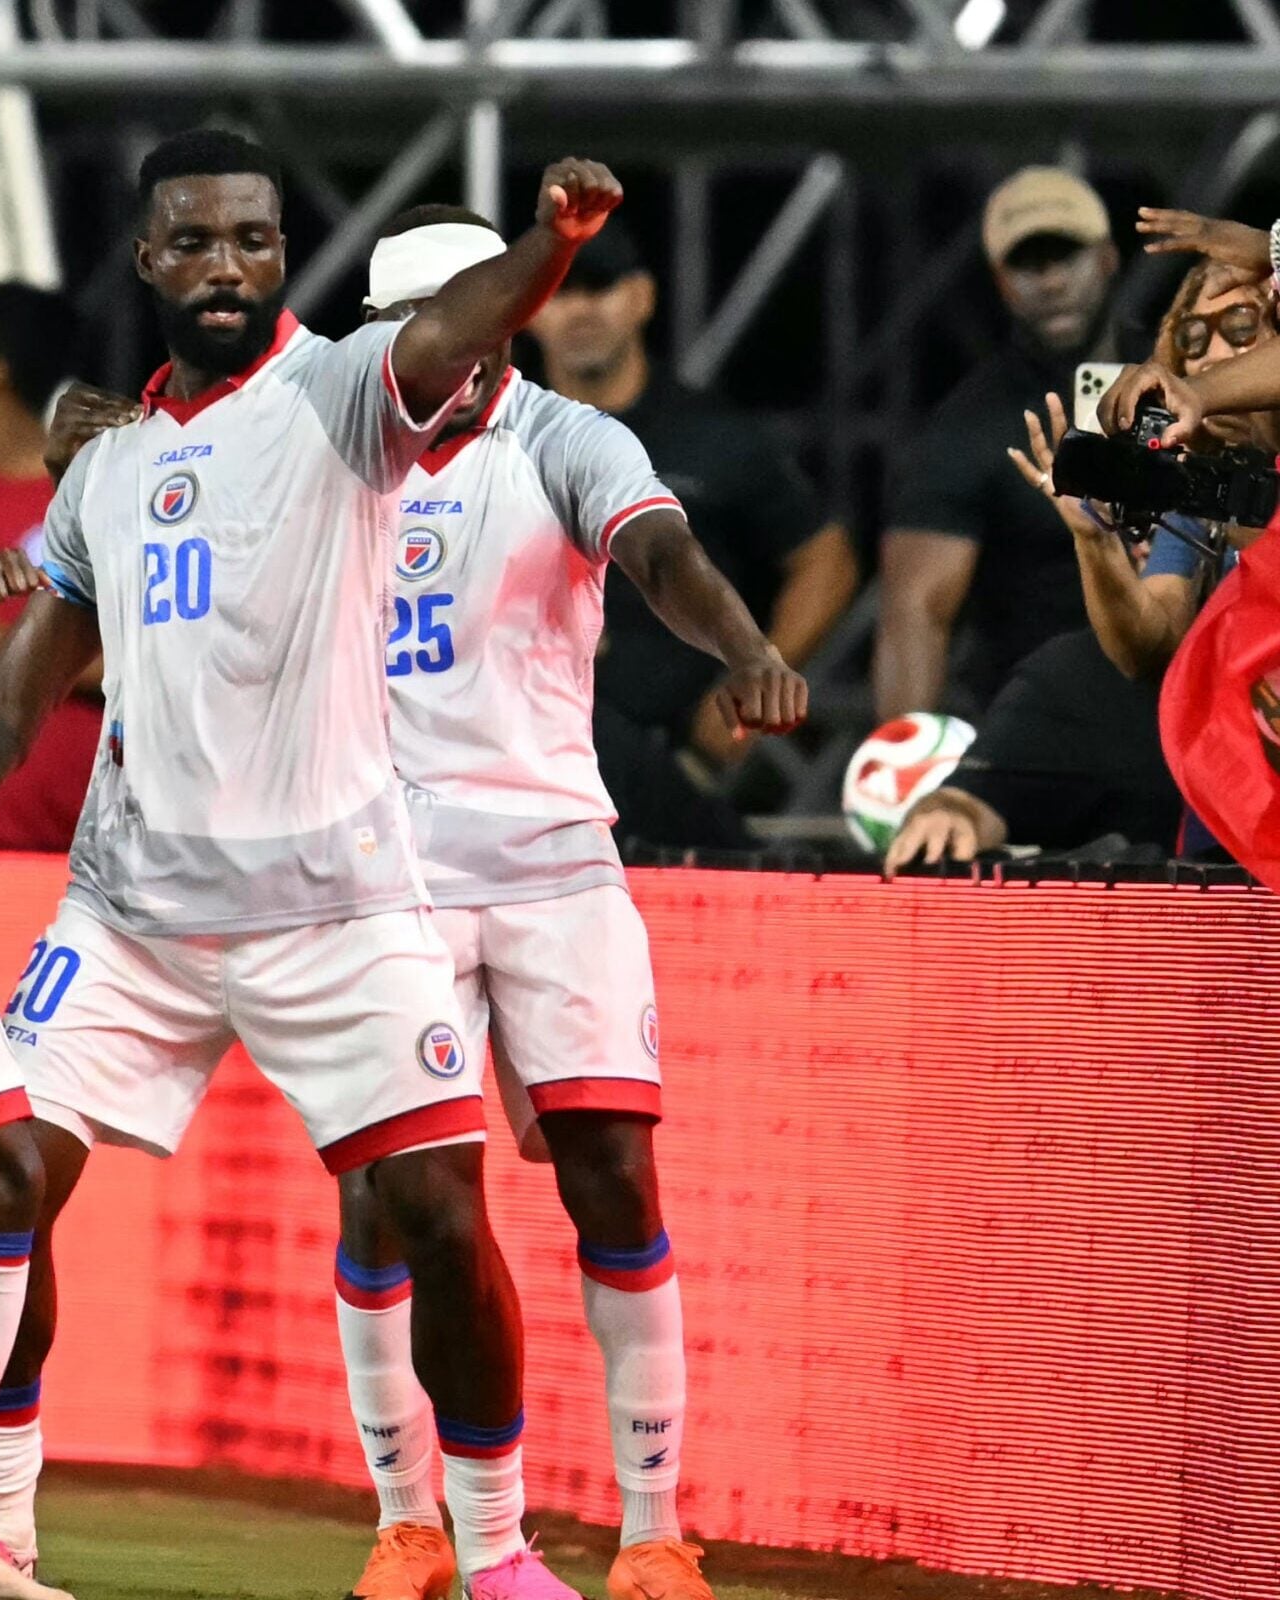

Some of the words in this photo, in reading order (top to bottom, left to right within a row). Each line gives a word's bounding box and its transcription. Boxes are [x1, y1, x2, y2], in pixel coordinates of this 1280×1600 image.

[153, 444, 213, 466] SAETA
[143, 537, 212, 626] 20
[386, 593, 455, 677] 25
[4, 1024, 38, 1047] ETA
[361, 1423, 401, 1439] FHF
[631, 1418, 673, 1434] FHF
